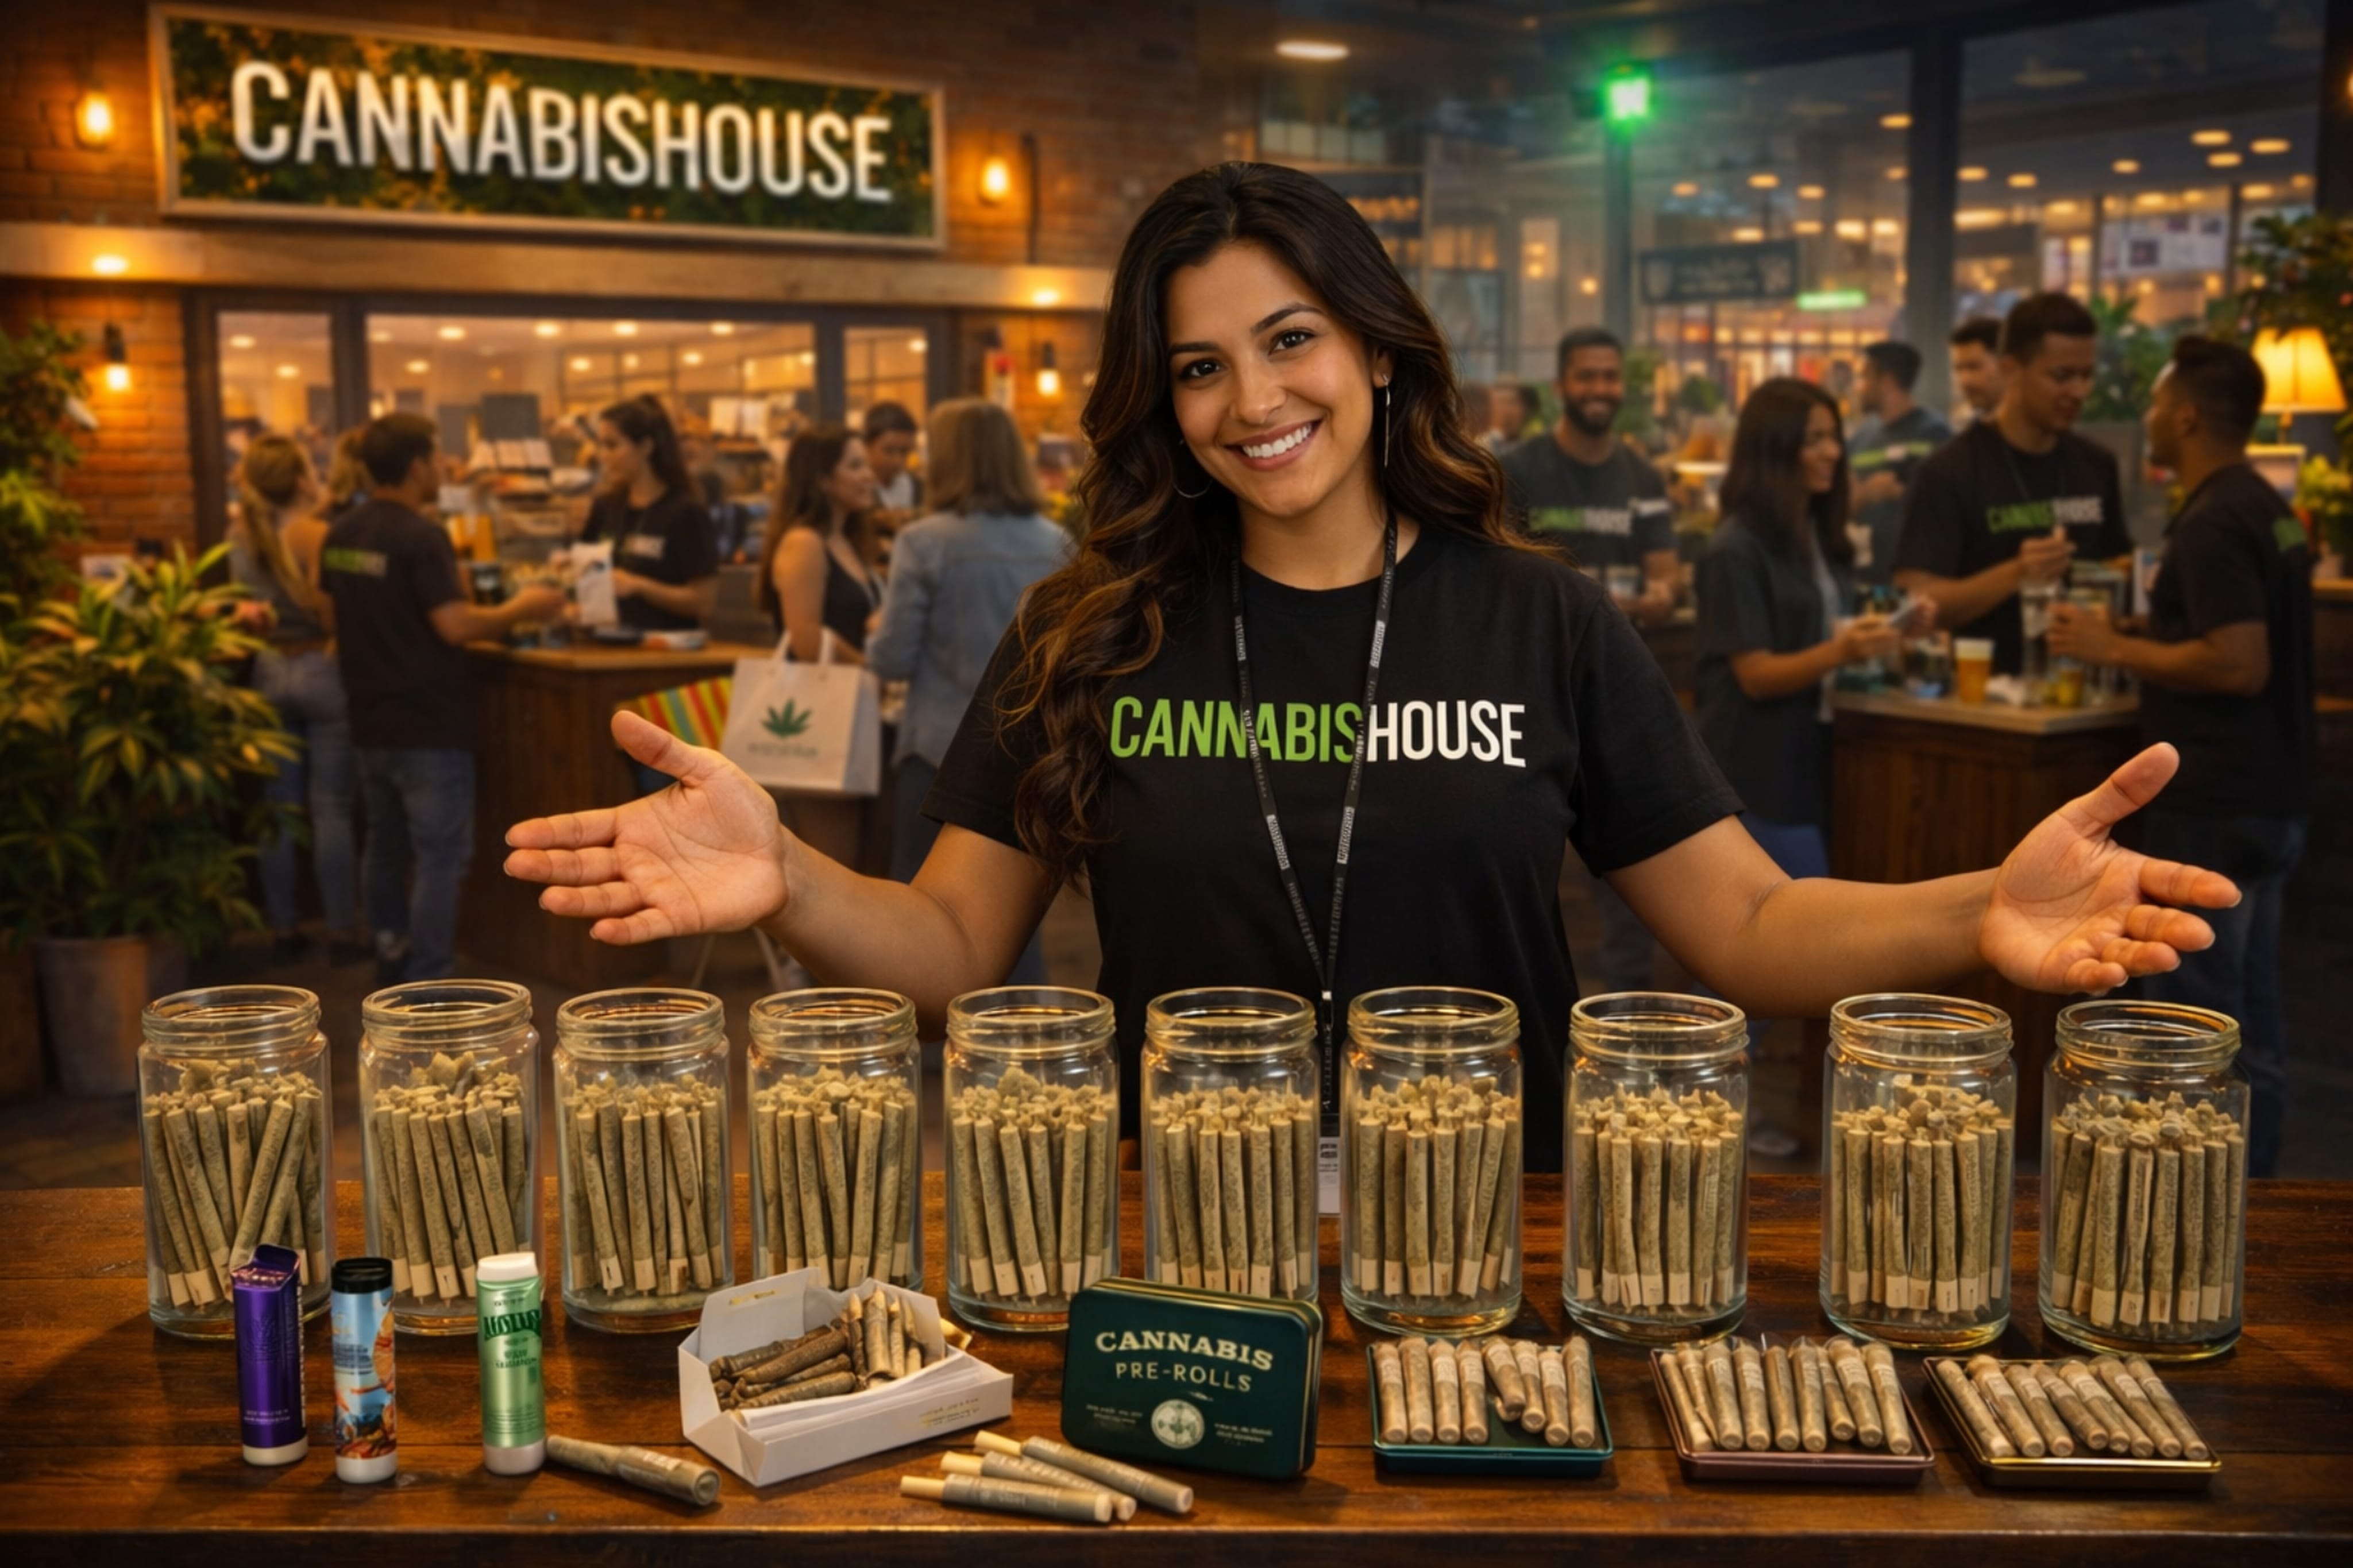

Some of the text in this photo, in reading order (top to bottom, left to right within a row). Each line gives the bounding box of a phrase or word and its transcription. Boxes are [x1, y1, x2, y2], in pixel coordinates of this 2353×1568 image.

[232, 61, 892, 202] CANNABISHOUSE
[1096, 1331, 1273, 1371] CANNABIS
[1116, 1362, 1252, 1392] PRE-ROLLS
